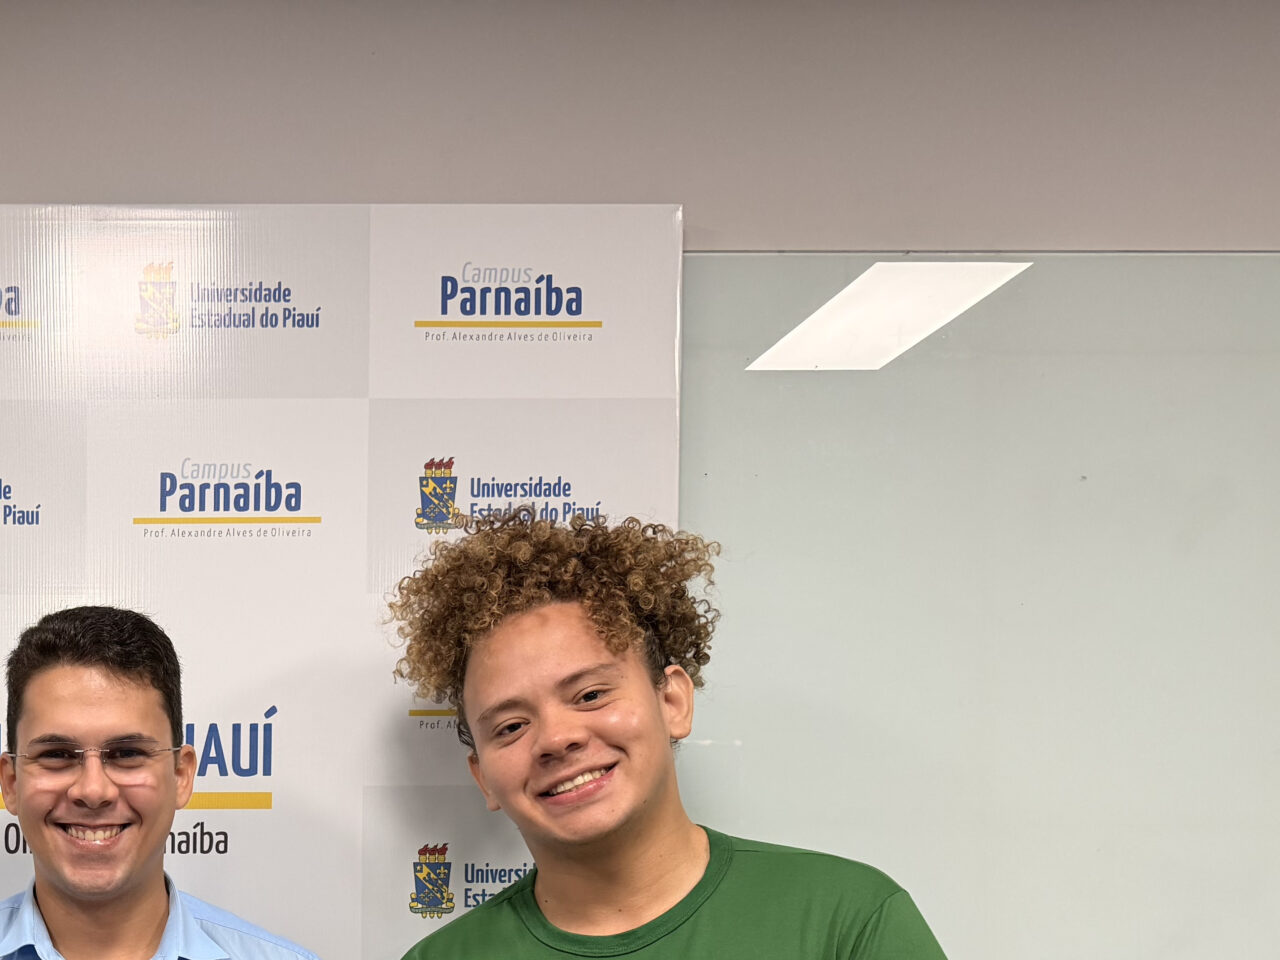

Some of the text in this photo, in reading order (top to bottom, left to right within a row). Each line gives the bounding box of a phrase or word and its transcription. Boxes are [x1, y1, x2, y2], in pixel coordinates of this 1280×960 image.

[462, 262, 533, 285] Campus
[191, 281, 292, 304] Universidade
[440, 274, 582, 316] Parnaíba
[191, 306, 322, 329] Estadual do Piauí
[425, 331, 593, 341] Prof. Alexandre Alves de Oliveira
[181, 458, 252, 482] Campus
[160, 470, 302, 512] Parnaíba
[470, 476, 572, 499] Universidade
[3, 503, 41, 526] Piauí
[540, 501, 559, 523] do
[143, 527, 312, 538] Prof. Alexandre Alves de Oliveira
[186, 705, 278, 777] AUÍ
[164, 821, 229, 855] naíba
[464, 862, 532, 884] Universi
